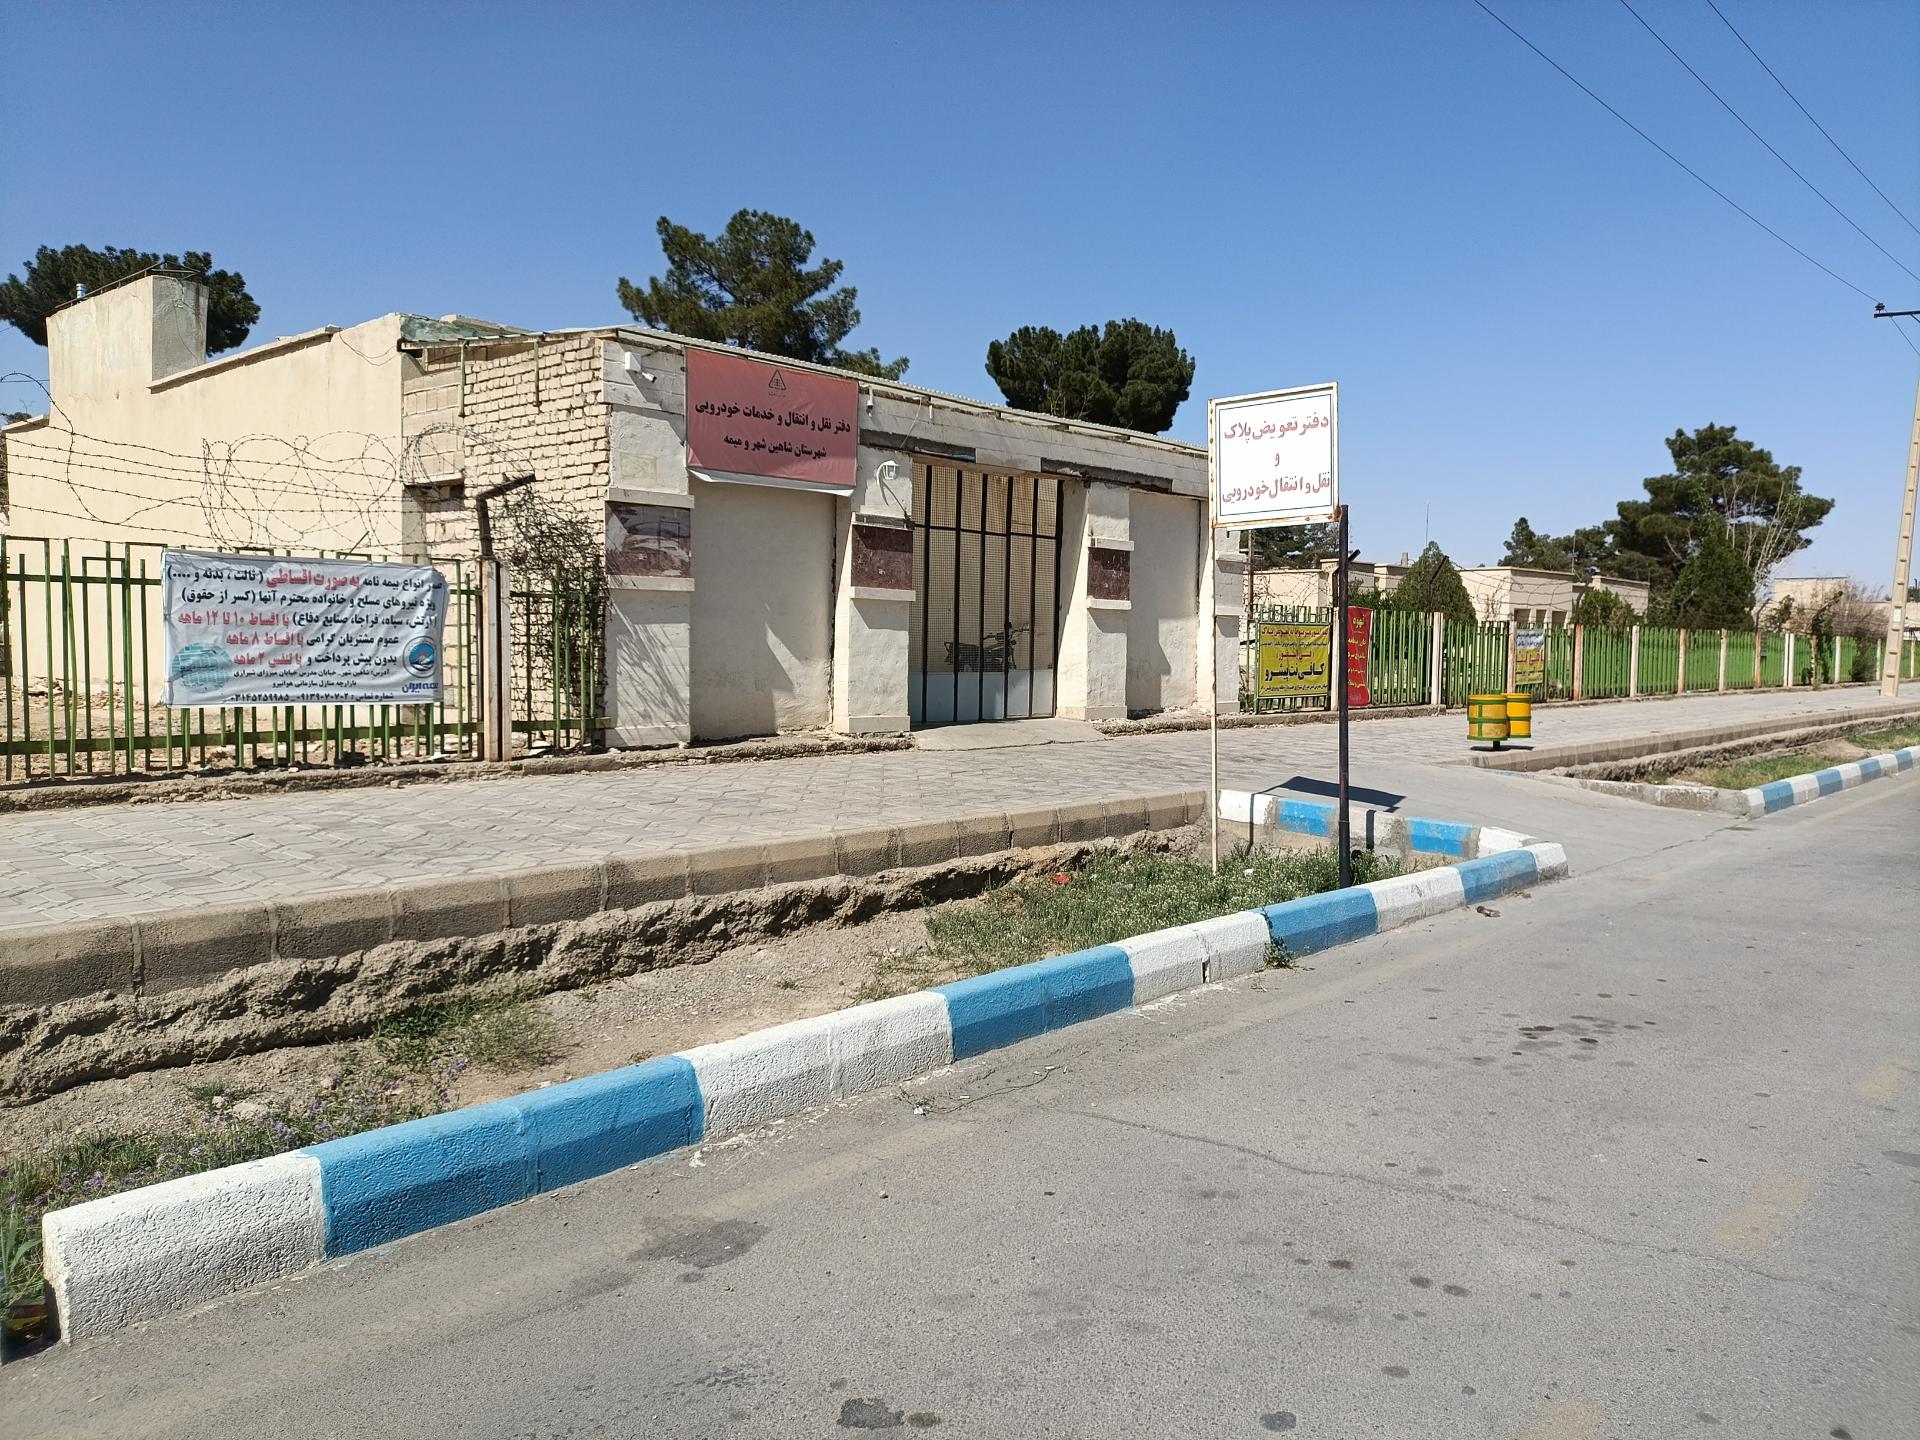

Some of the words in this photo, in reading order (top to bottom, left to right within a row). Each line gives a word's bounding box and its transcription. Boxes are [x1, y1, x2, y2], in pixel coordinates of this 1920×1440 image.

[695, 401, 740, 418] خودرویی
[743, 405, 775, 421] خدمات
[777, 415, 783, 426] و
[785, 411, 808, 426] انتقال
[817, 416, 832, 432] نقل
[1299, 411, 1329, 435] دفتر
[810, 421, 816, 432] و
[834, 419, 851, 435] دفتر
[1224, 421, 1251, 444] پلاک
[1252, 416, 1298, 441] تعویض
[723, 435, 743, 449] میمه
[744, 439, 749, 450] و
[751, 437, 766, 451] شهر
[768, 441, 792, 454] شاهین
[795, 443, 827, 460] شهرستان
[1274, 452, 1280, 467] و
[1269, 475, 1303, 498] انتقال
[1304, 482, 1311, 494] و
[1312, 471, 1330, 493] نقل
[1222, 480, 1269, 504] خودرویی
[195, 571, 200, 582] و
[203, 568, 224, 582] بدنه
[266, 569, 311, 588] اقساطی
[313, 573, 348, 591] صورت
[363, 576, 379, 587] نامه
[350, 575, 360, 590] به
[382, 579, 399, 590] بیمه
[402, 578, 424, 591] انواع
[181, 587, 215, 603] حقوق)
[218, 589, 228, 604] از
[231, 590, 256, 604] (کسر
[259, 589, 276, 604] آنها
[281, 593, 309, 606] محترم
[312, 594, 346, 607] خانواده
[357, 595, 380, 608] مسلح
[350, 598, 355, 608] و
[383, 597, 417, 610] نیروهای
[420, 598, 436, 611] ویژه
[178, 610, 202, 625] ماهه
[223, 611, 230, 625] تا
[234, 610, 245, 625] ۱۰
[249, 611, 279, 626] اقساط
[283, 612, 289, 629] با
[293, 611, 319, 627] دفاع)
[322, 614, 348, 627] صنایع
[226, 631, 249, 645] ماهه
[252, 631, 260, 645] ۸
[264, 631, 294, 645] اقساط
[297, 632, 304, 648] با
[306, 632, 336, 647] گرامی
[338, 633, 374, 647] مشتریان
[377, 638, 399, 647] عموم
[234, 652, 256, 665] ماهه
[296, 652, 302, 667] با
[307, 657, 312, 666] و
[314, 652, 350, 667] پرداخت
[353, 654, 371, 667] پیش
[375, 656, 397, 666] بدون
[279, 669, 298, 677] خیابان
[318, 669, 337, 677] خیابان
[353, 669, 370, 677] شاهین
[1264, 663, 1289, 682] پیشرو
[1297, 662, 1325, 680] کافی
[402, 682, 422, 693] ایران
